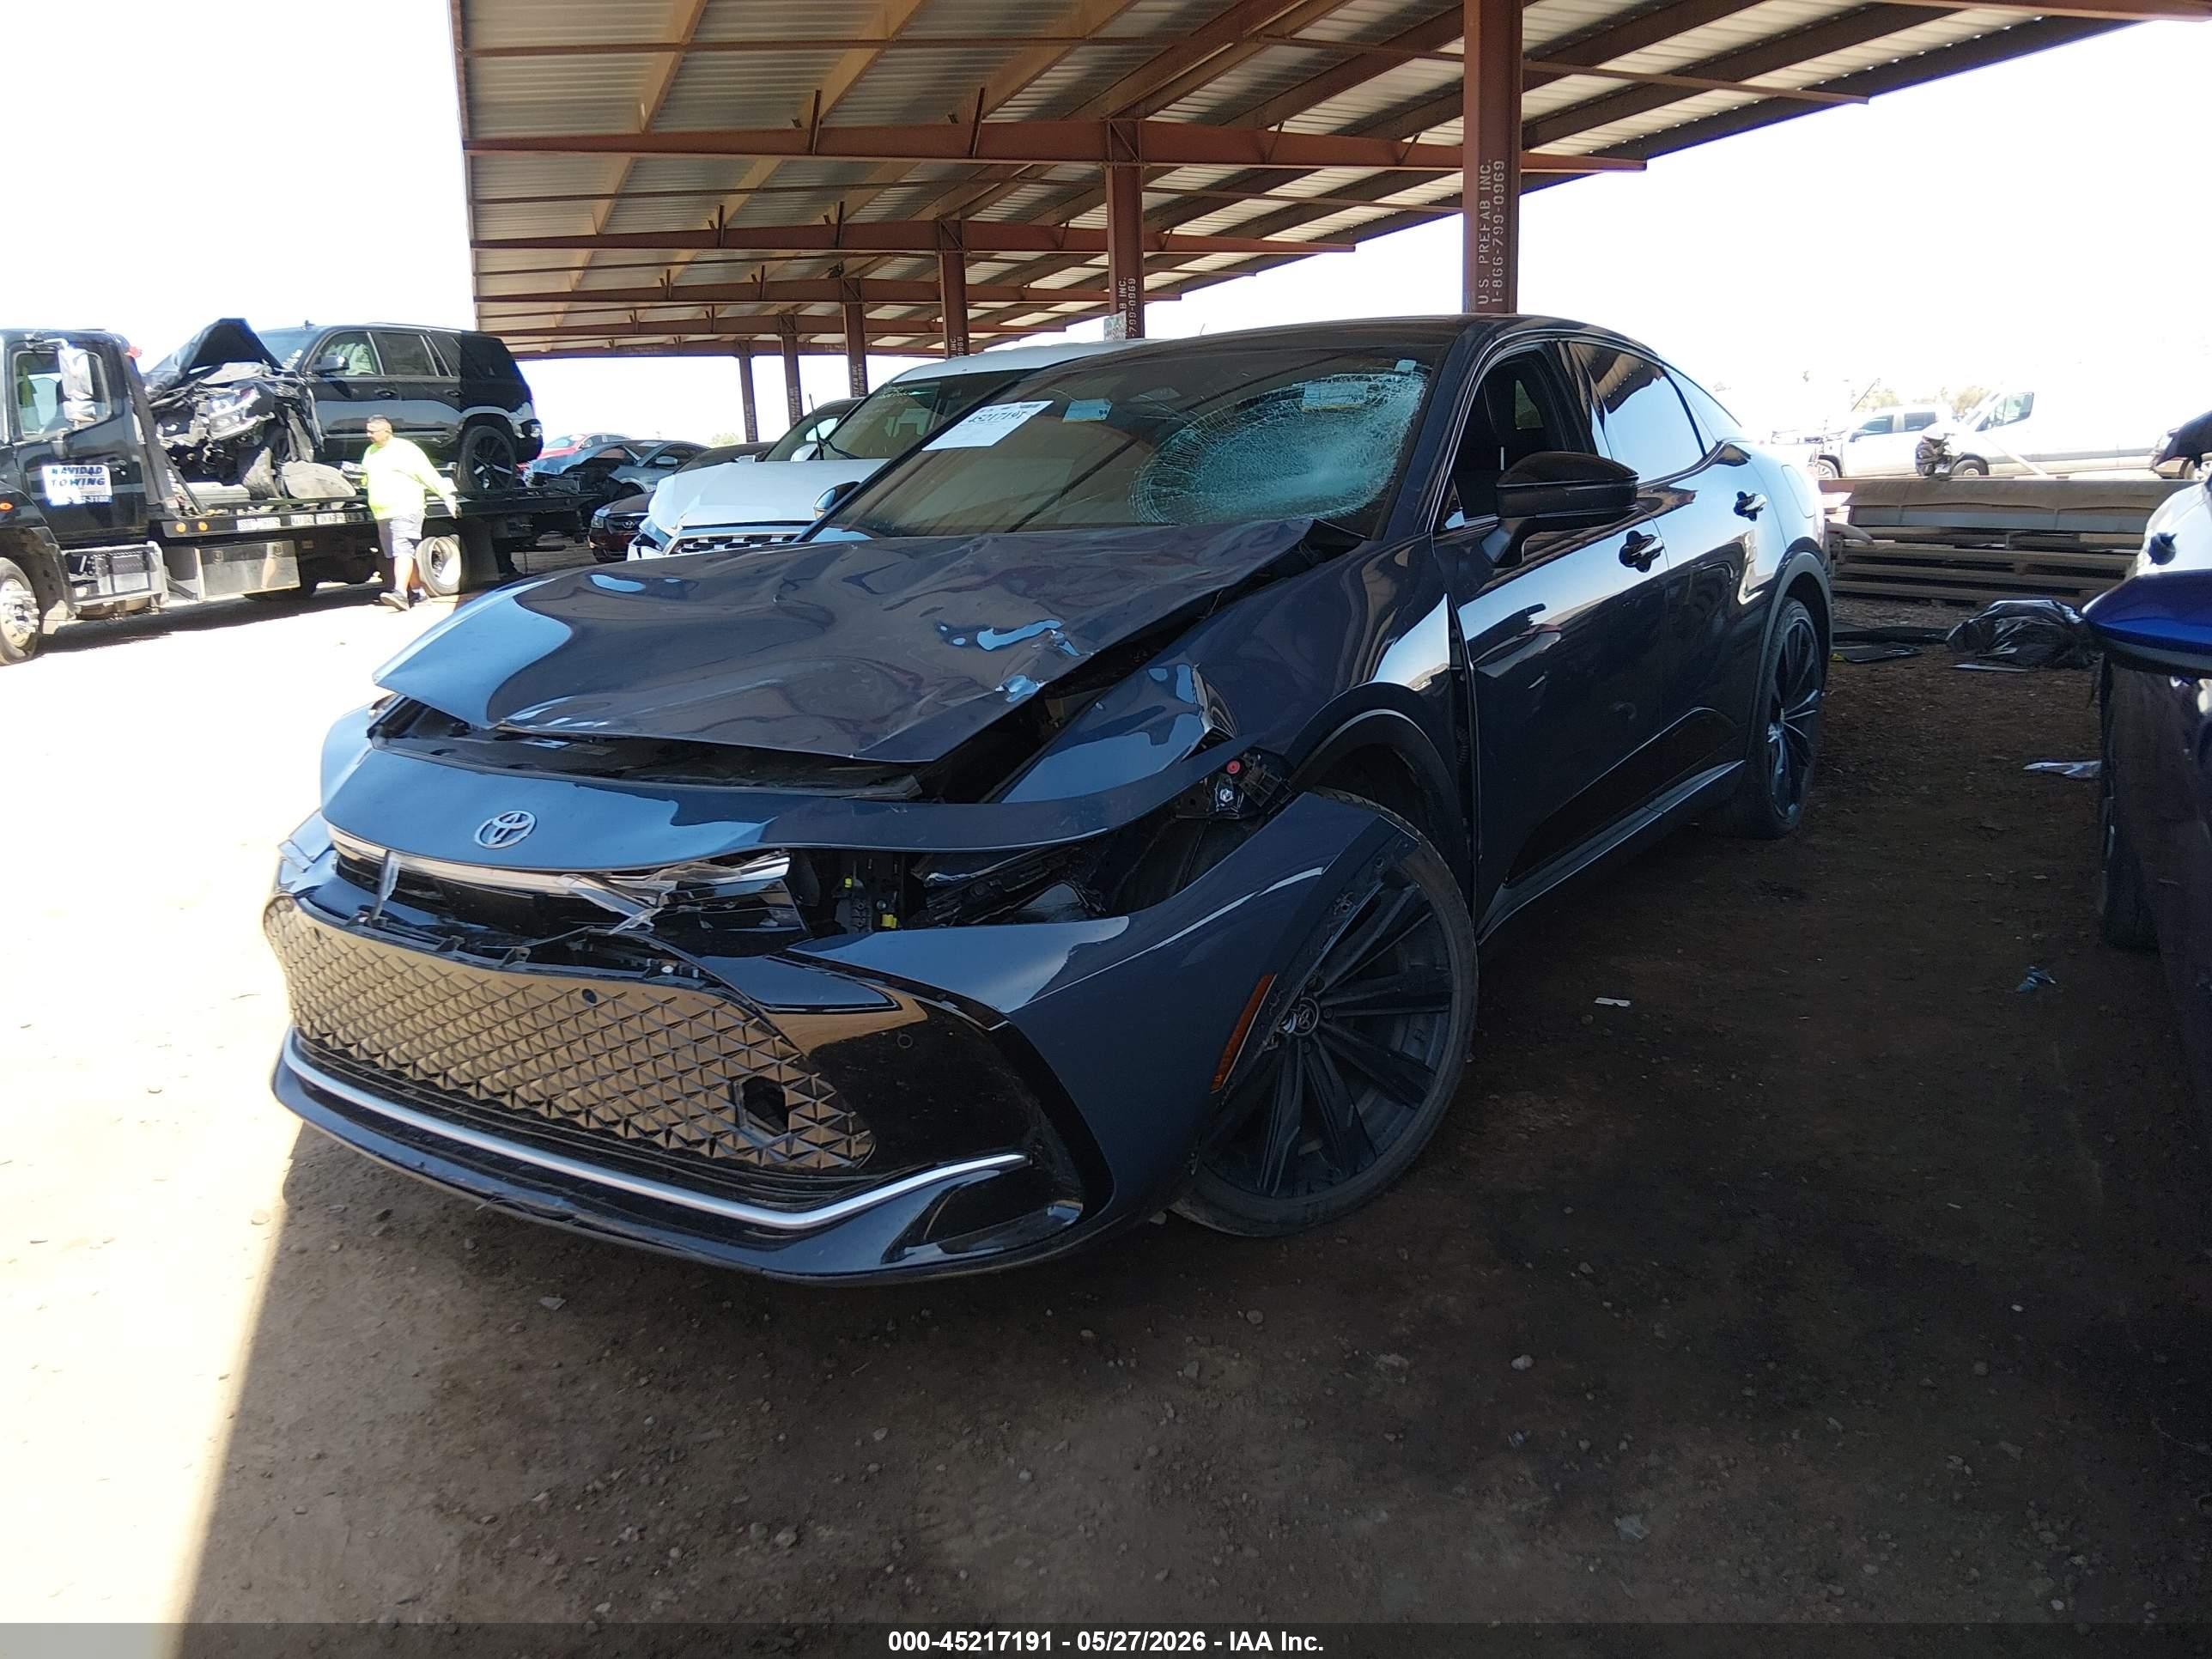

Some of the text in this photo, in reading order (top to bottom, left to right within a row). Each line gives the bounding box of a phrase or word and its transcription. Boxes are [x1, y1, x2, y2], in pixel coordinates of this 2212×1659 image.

[1477, 158, 1492, 305] U.S. PREFAB INC.
[1491, 161, 1505, 303] 1-866-799-0969
[51, 465, 103, 476] NAVIDAD
[51, 477, 106, 487] TOWING
